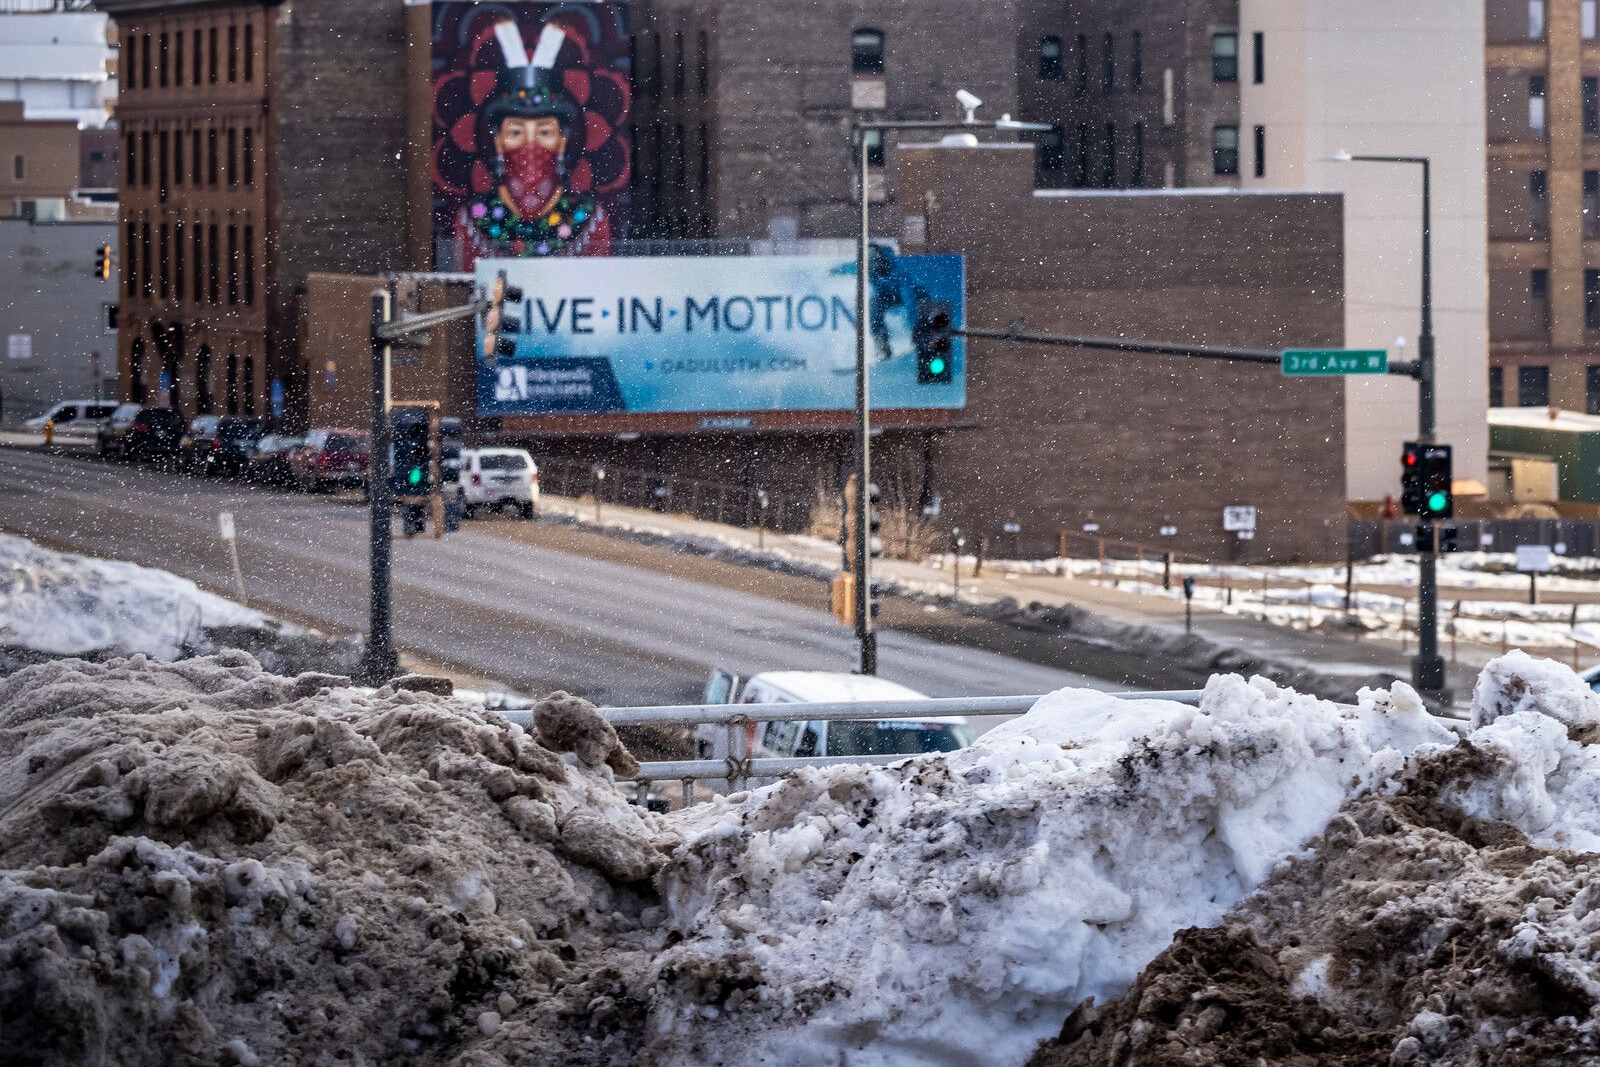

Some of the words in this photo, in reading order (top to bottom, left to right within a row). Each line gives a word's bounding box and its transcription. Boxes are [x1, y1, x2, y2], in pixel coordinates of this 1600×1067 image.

[524, 299, 594, 334] IVE
[617, 297, 662, 333] IN
[685, 295, 856, 332] MOTION
[1289, 356, 1318, 370] 3rd
[1327, 356, 1358, 369] Ave
